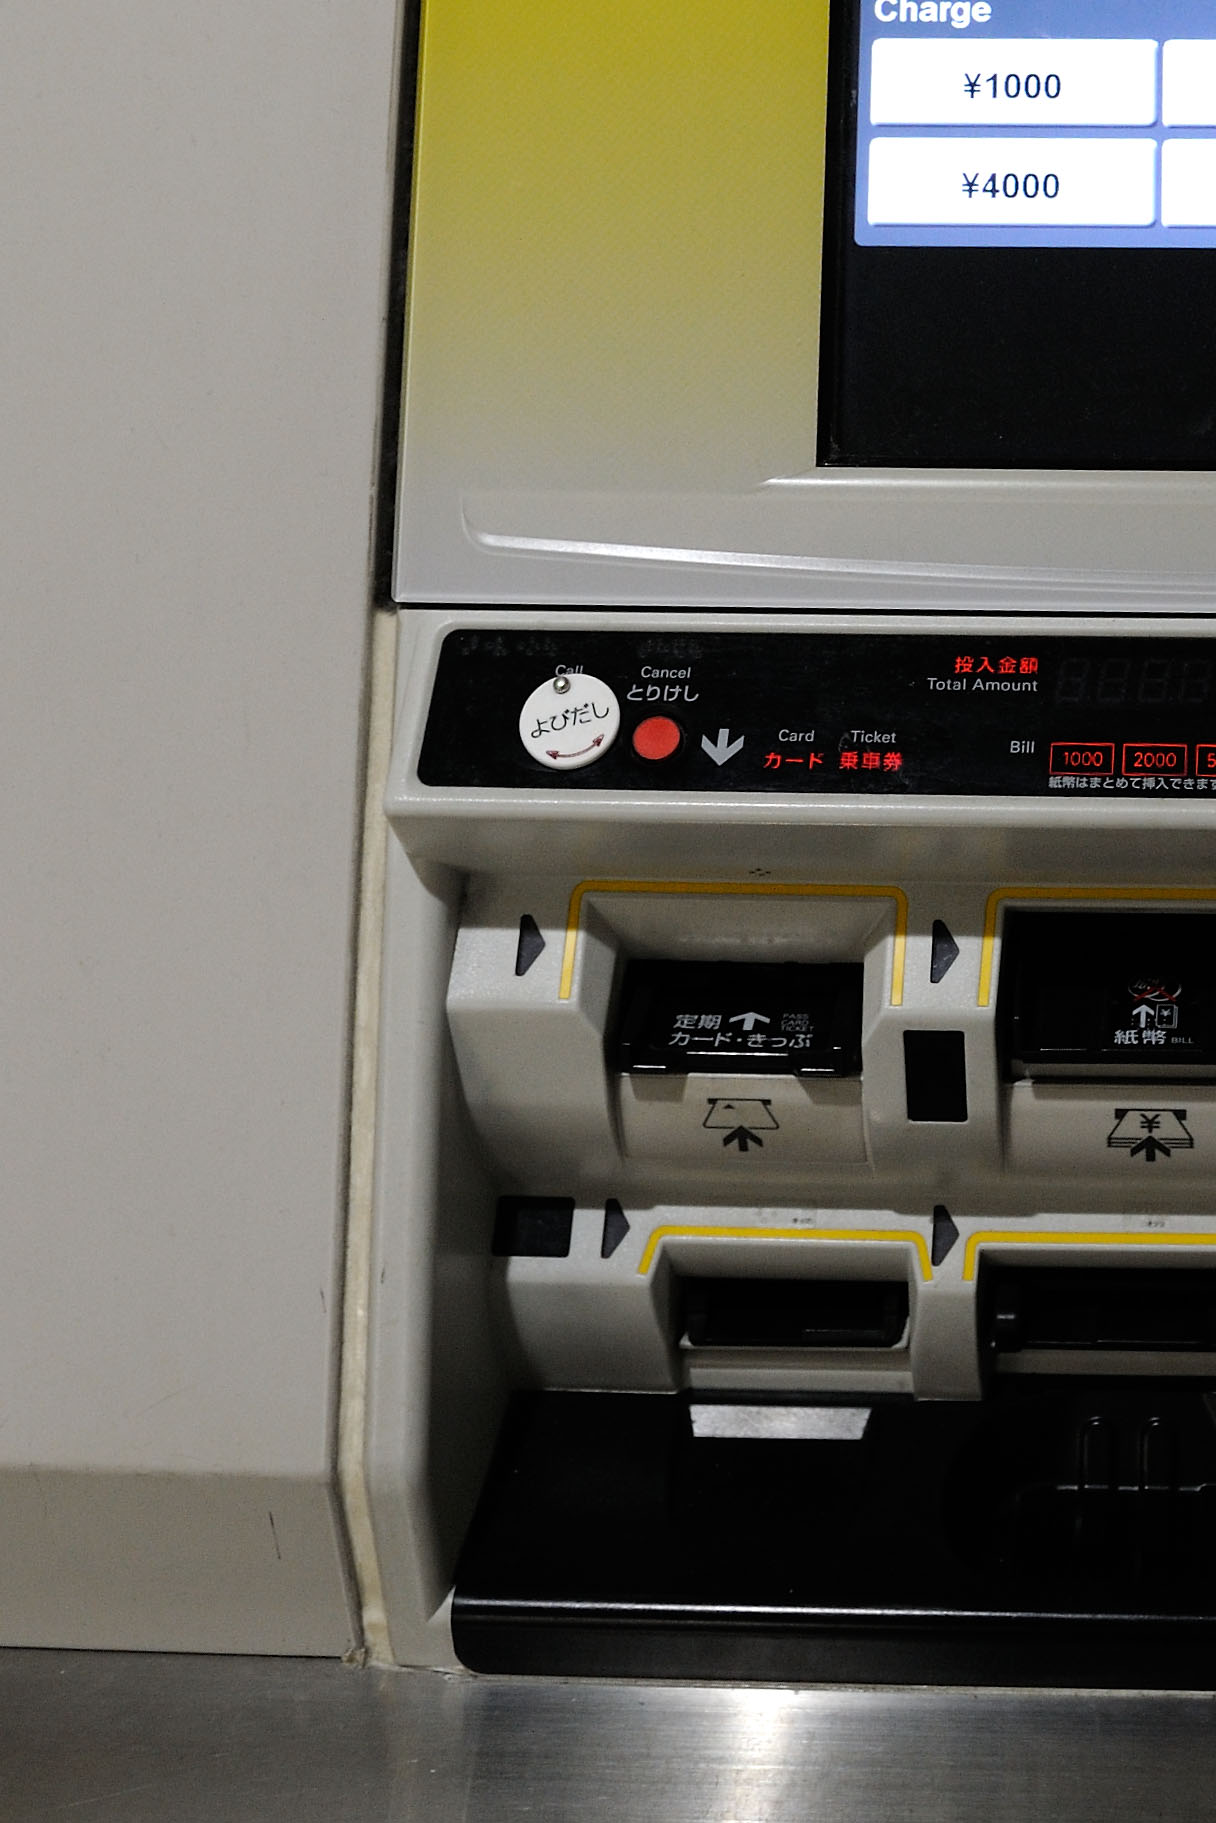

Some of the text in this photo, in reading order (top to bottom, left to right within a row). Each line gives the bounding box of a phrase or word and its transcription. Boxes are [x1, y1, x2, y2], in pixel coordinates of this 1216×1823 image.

[964, 74, 1060, 98] ¥1000
[963, 173, 1059, 198] ¥4000
[555, 664, 584, 675] Call
[955, 656, 1038, 673] 投入金額
[641, 666, 691, 678] Cancel
[928, 678, 1037, 691] Total Amount
[627, 685, 699, 701] とりけし
[531, 702, 609, 738] よびだし
[779, 729, 814, 741] Card
[851, 730, 896, 743] Ticket
[1010, 741, 1034, 753] Bill
[764, 752, 823, 768] カード
[840, 752, 902, 771] 乗車券
[1064, 752, 1103, 766] 1000
[1134, 752, 1176, 767] 2000
[674, 1015, 722, 1029] 定期
[1114, 1030, 1166, 1044] 紙幣
